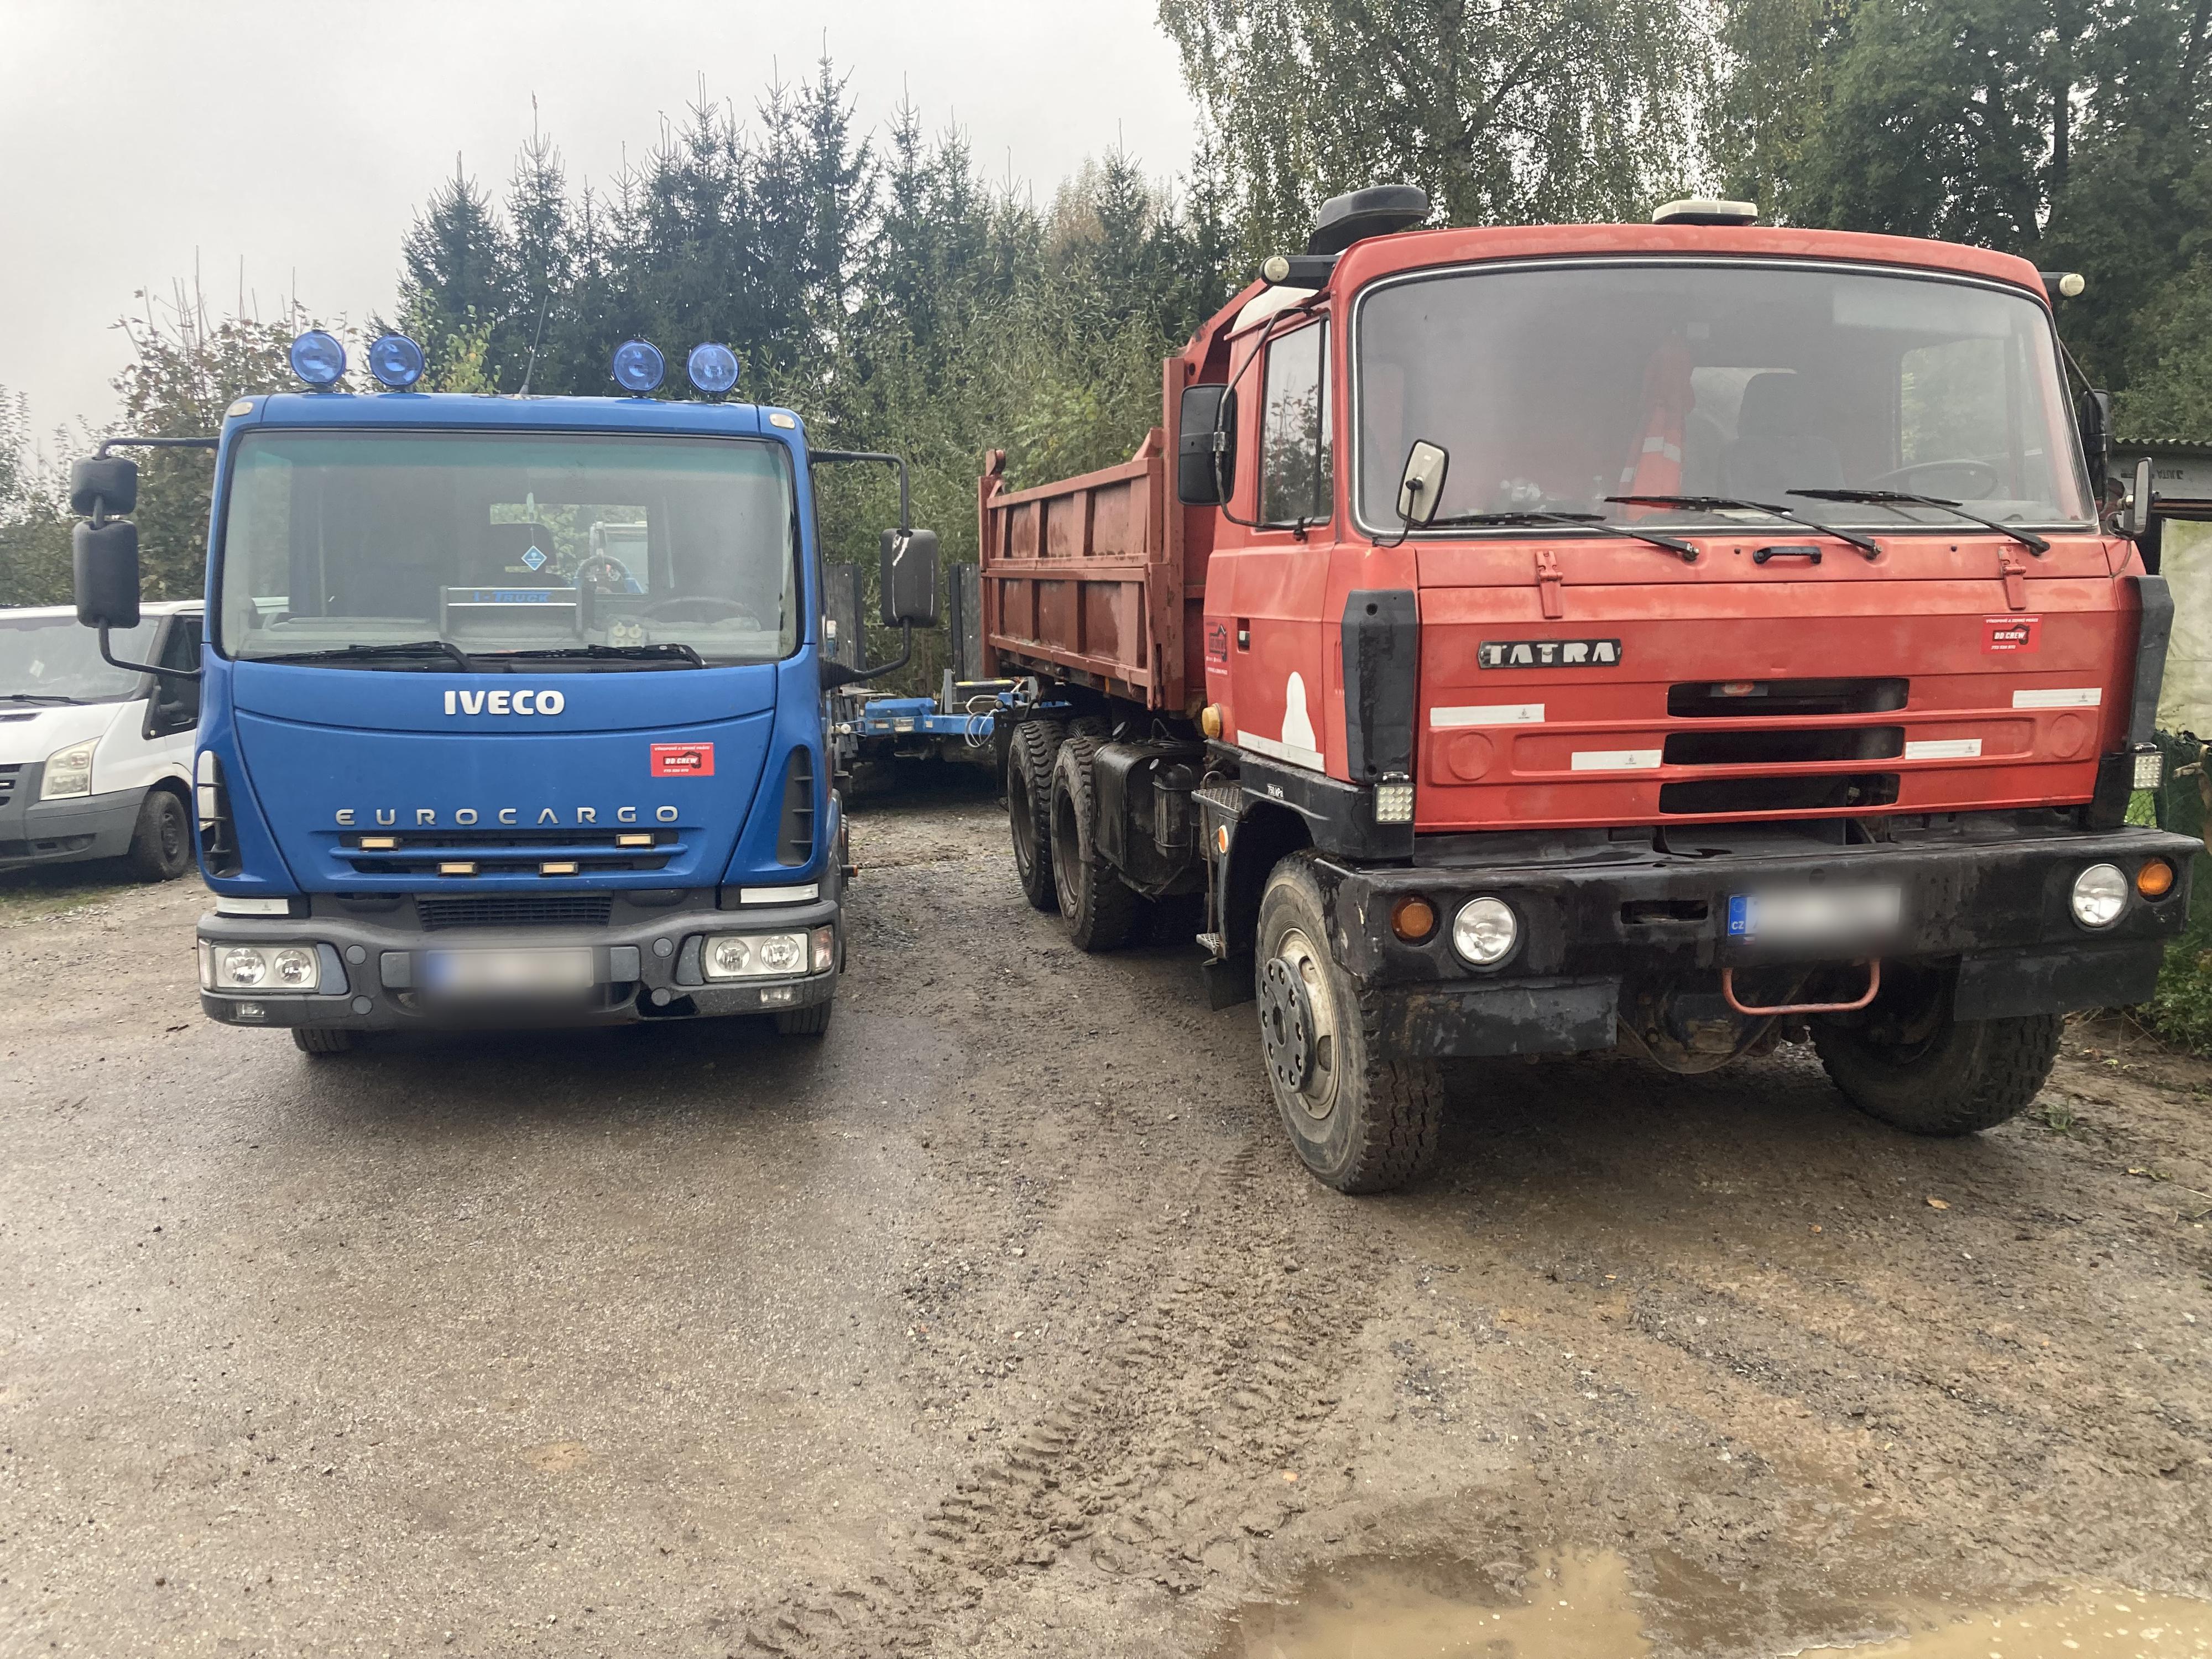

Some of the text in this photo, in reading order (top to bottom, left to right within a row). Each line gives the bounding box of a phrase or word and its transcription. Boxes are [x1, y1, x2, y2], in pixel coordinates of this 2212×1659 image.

[1485, 642, 1615, 664] TATRA
[445, 690, 565, 714] IVECO
[335, 806, 679, 826] EUROCARGO
[1731, 920, 1744, 930] CZ
